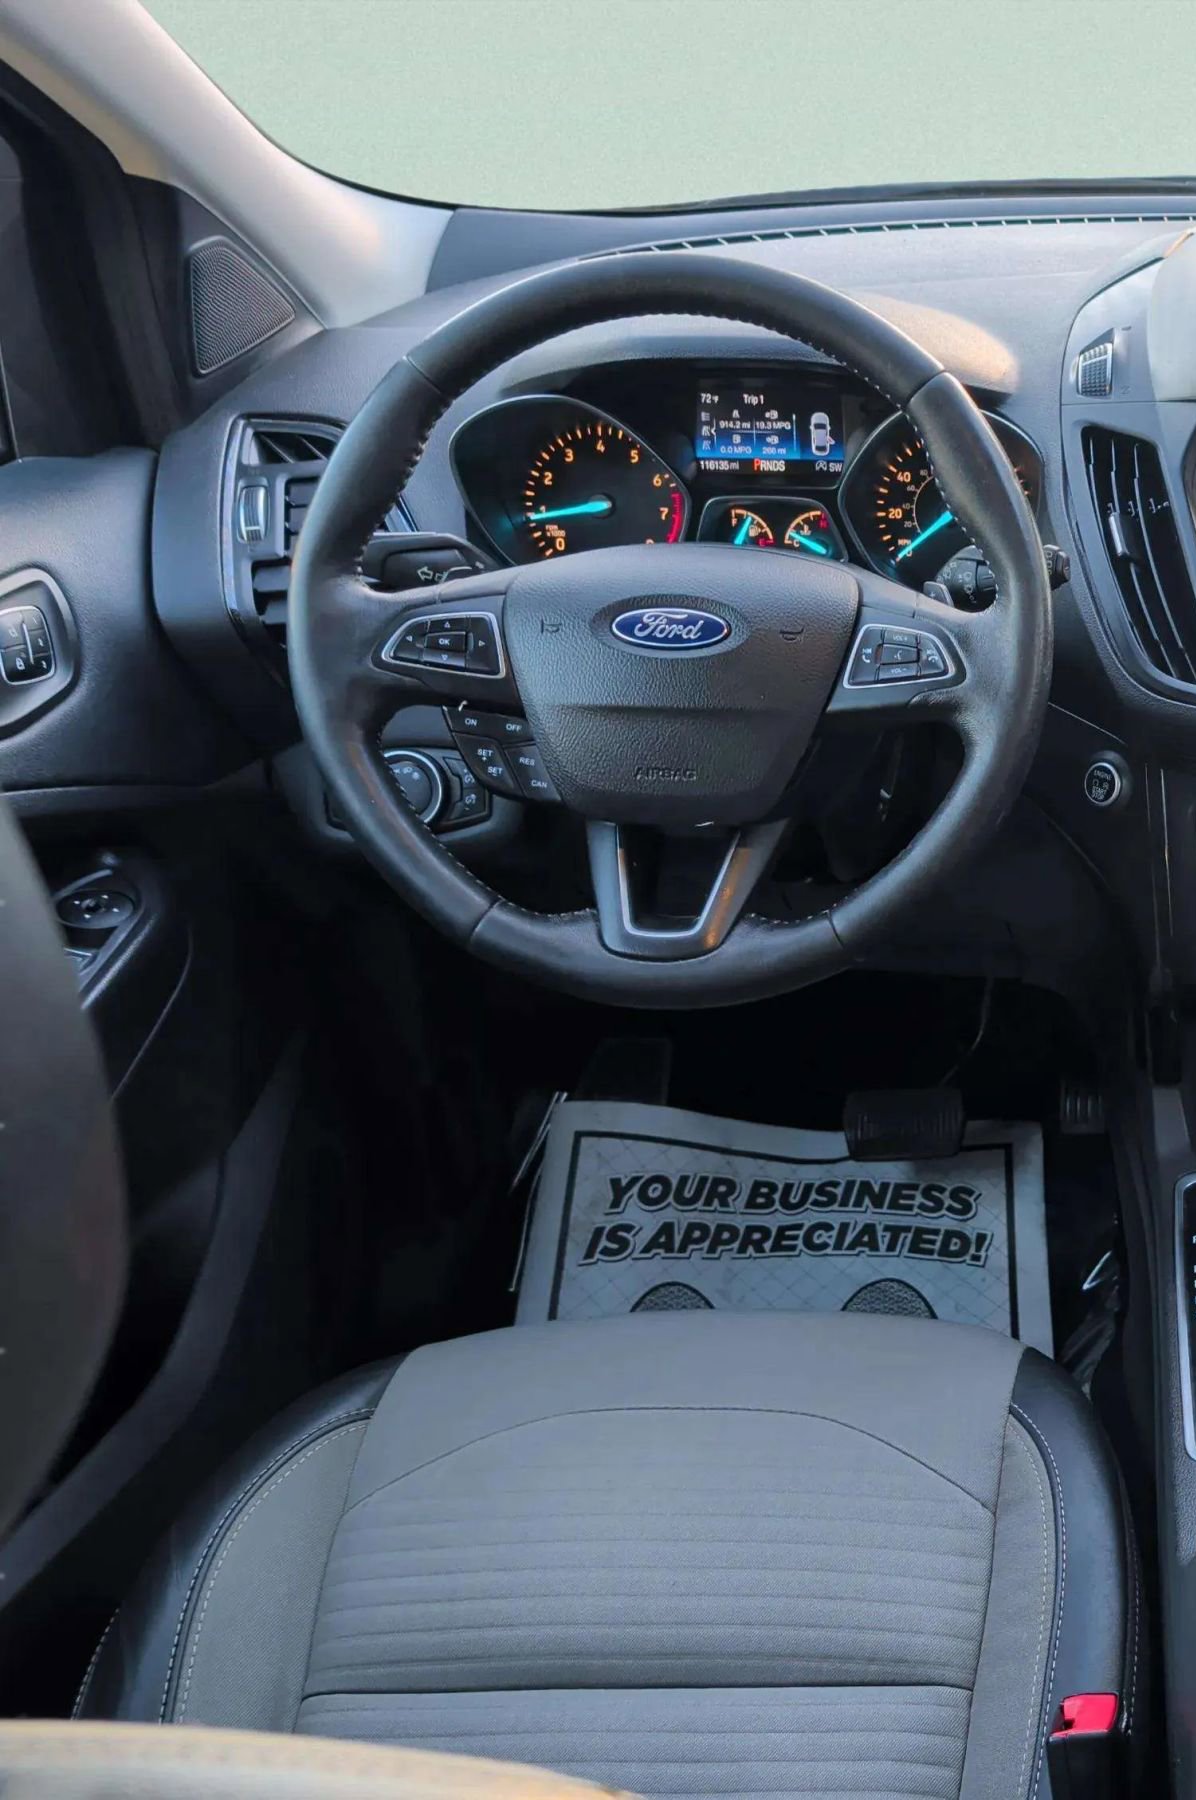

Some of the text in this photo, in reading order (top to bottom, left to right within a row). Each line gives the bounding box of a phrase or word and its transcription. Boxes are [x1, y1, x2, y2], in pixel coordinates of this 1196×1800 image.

[742, 393, 764, 406] Trip 1
[719, 421, 751, 429] 914.2 mi
[772, 421, 791, 430] MPG
[596, 440, 605, 453] 4
[720, 446, 752, 454] 0.0 MPG
[777, 447, 786, 455] mi
[564, 448, 574, 462] 3
[630, 450, 639, 464] 5
[829, 463, 843, 472] SW
[543, 471, 553, 486] 2
[653, 474, 662, 487] 6
[896, 471, 912, 483] 40
[659, 507, 669, 521] 7
[888, 508, 903, 519] 20
[556, 538, 565, 550] 0
[634, 612, 704, 640] Ford
[464, 718, 477, 726] ON
[505, 723, 522, 732] OFF
[477, 748, 493, 757] SET
[519, 756, 535, 766] RES
[487, 766, 503, 775] SET
[531, 779, 548, 788] CAN
[606, 1173, 978, 1219] YOUR BUSINESS
[580, 1220, 990, 1265] IS APPRECIATED!
